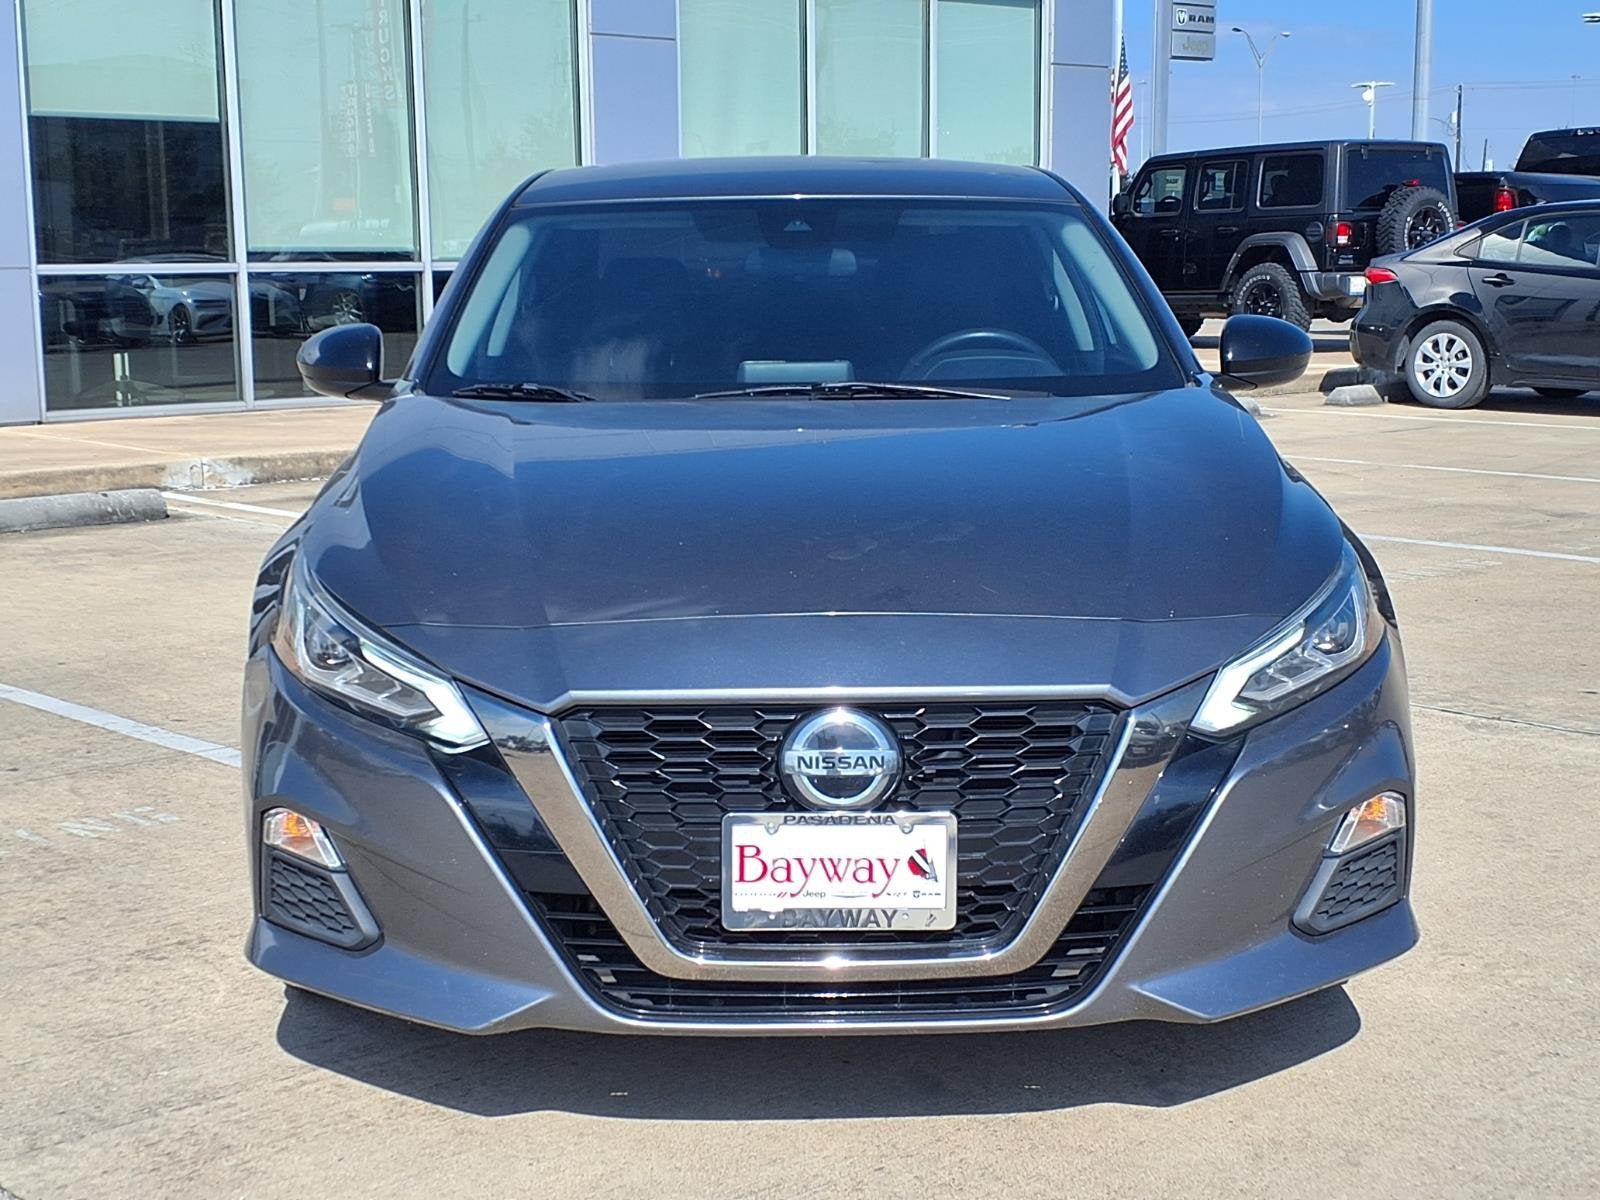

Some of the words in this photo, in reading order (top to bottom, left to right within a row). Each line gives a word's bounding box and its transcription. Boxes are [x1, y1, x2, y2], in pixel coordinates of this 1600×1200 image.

[1188, 14, 1215, 24] RAM
[797, 755, 885, 770] NISSAN
[783, 815, 896, 825] PASADENA
[734, 844, 901, 898] Bayway
[802, 889, 827, 899] Jeep
[782, 908, 898, 928] BAYWAY
